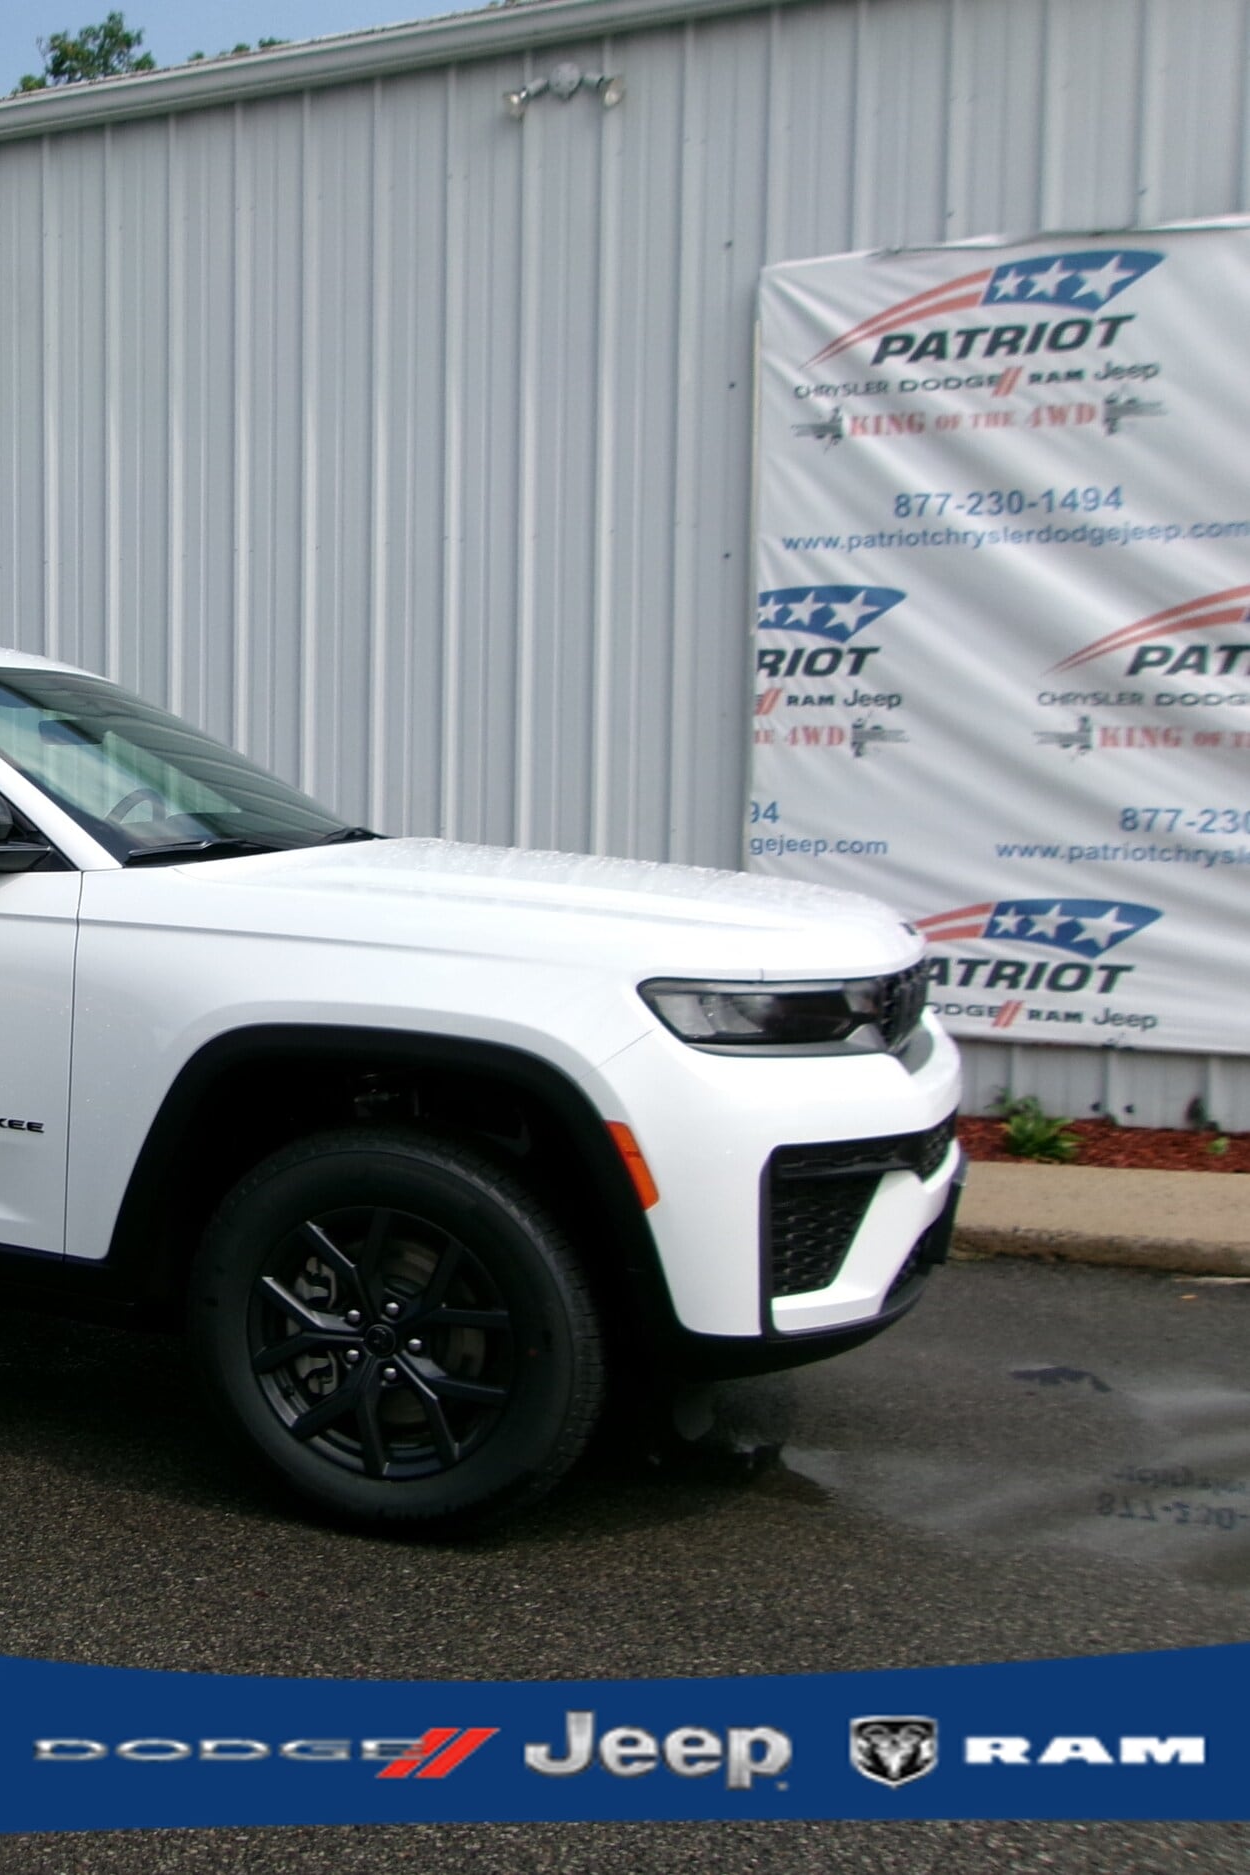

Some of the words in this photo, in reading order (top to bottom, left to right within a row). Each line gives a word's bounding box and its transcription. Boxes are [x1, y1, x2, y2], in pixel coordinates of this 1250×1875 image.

[870, 314, 1137, 367] PATRIOT
[794, 380, 890, 399] CHRYSLER
[900, 374, 1004, 393] DODGE
[1029, 368, 1085, 385] RAM
[1094, 360, 1161, 383] Jeep
[849, 411, 926, 437] KING
[935, 414, 962, 431] OF
[971, 411, 1015, 430] THE
[1027, 403, 1097, 428] 4WD
[894, 485, 1124, 518] 877-230-1494
[781, 521, 1250, 553] www.patriotchryslerdodgejeep.com
[786, 693, 836, 707] RAM
[843, 688, 902, 709] Jeep
[1037, 691, 1145, 706] CHRYSLER
[785, 725, 845, 746] 4WD
[1100, 726, 1182, 748] KING
[1193, 731, 1221, 747] OF
[750, 834, 888, 857] gejeep.com
[1026, 1007, 1084, 1024] RAM
[1093, 1008, 1158, 1032] Jeep
